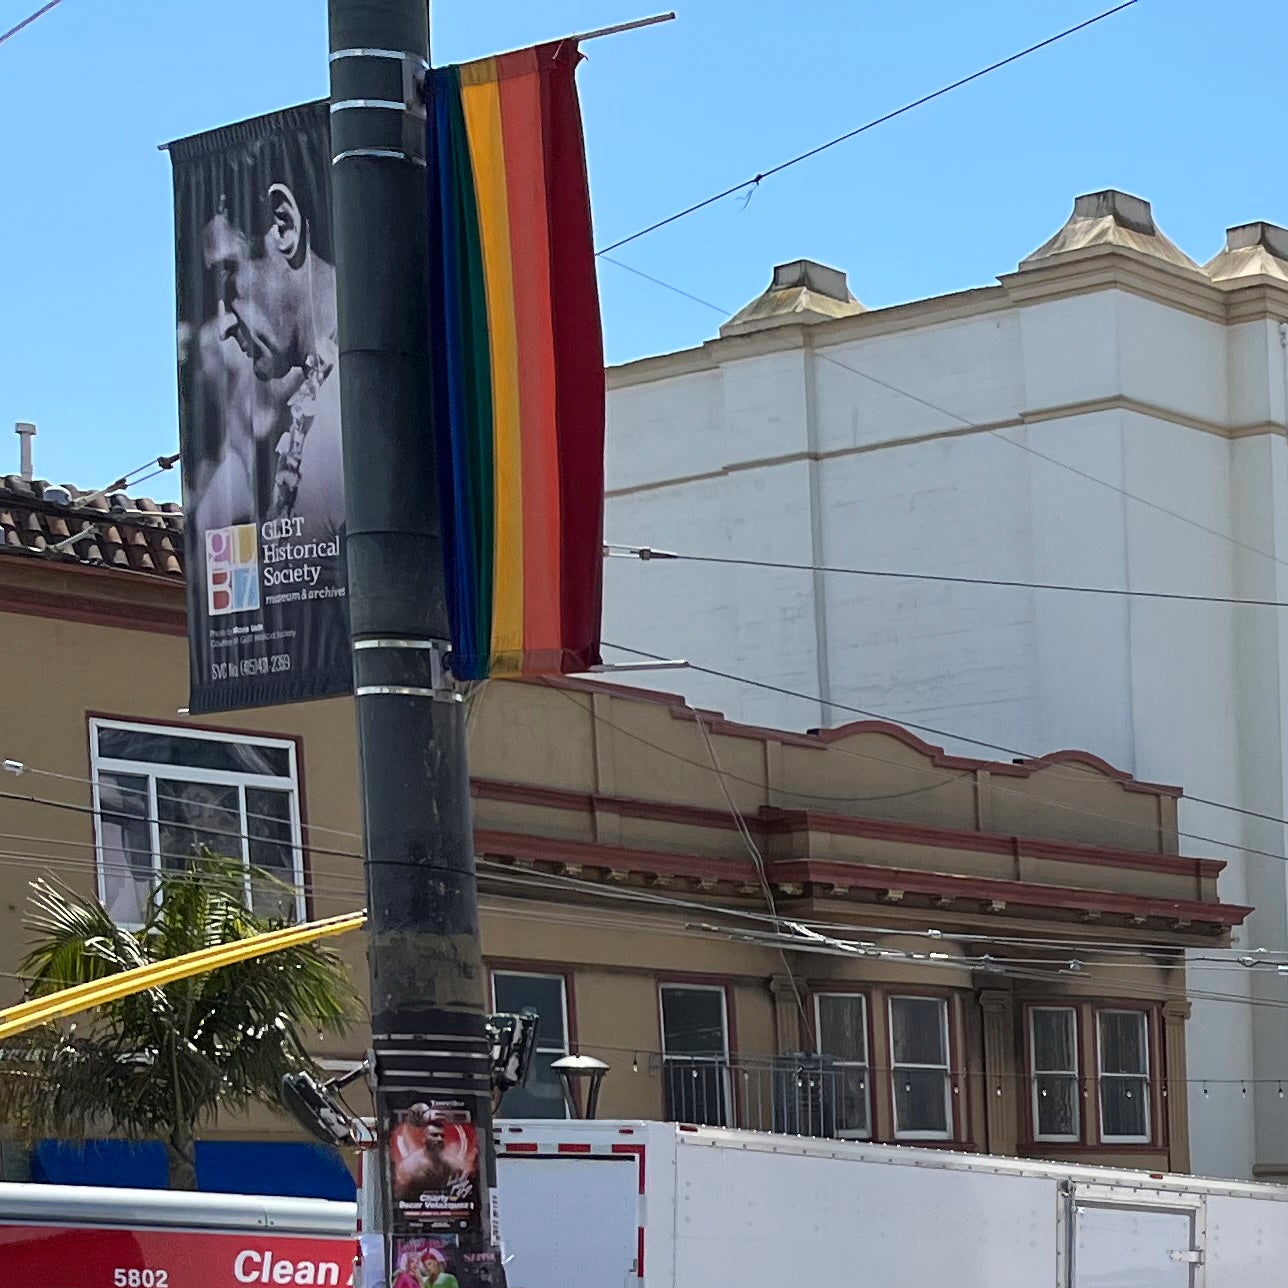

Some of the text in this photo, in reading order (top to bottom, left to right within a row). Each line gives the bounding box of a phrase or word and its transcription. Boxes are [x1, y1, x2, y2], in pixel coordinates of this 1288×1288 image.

[261, 517, 304, 540] GLBT
[262, 535, 340, 563] Historical
[263, 563, 321, 587] Society
[265, 592, 300, 605] museum
[301, 588, 307, 600] &
[114, 1250, 339, 1288] 5802 Clean
